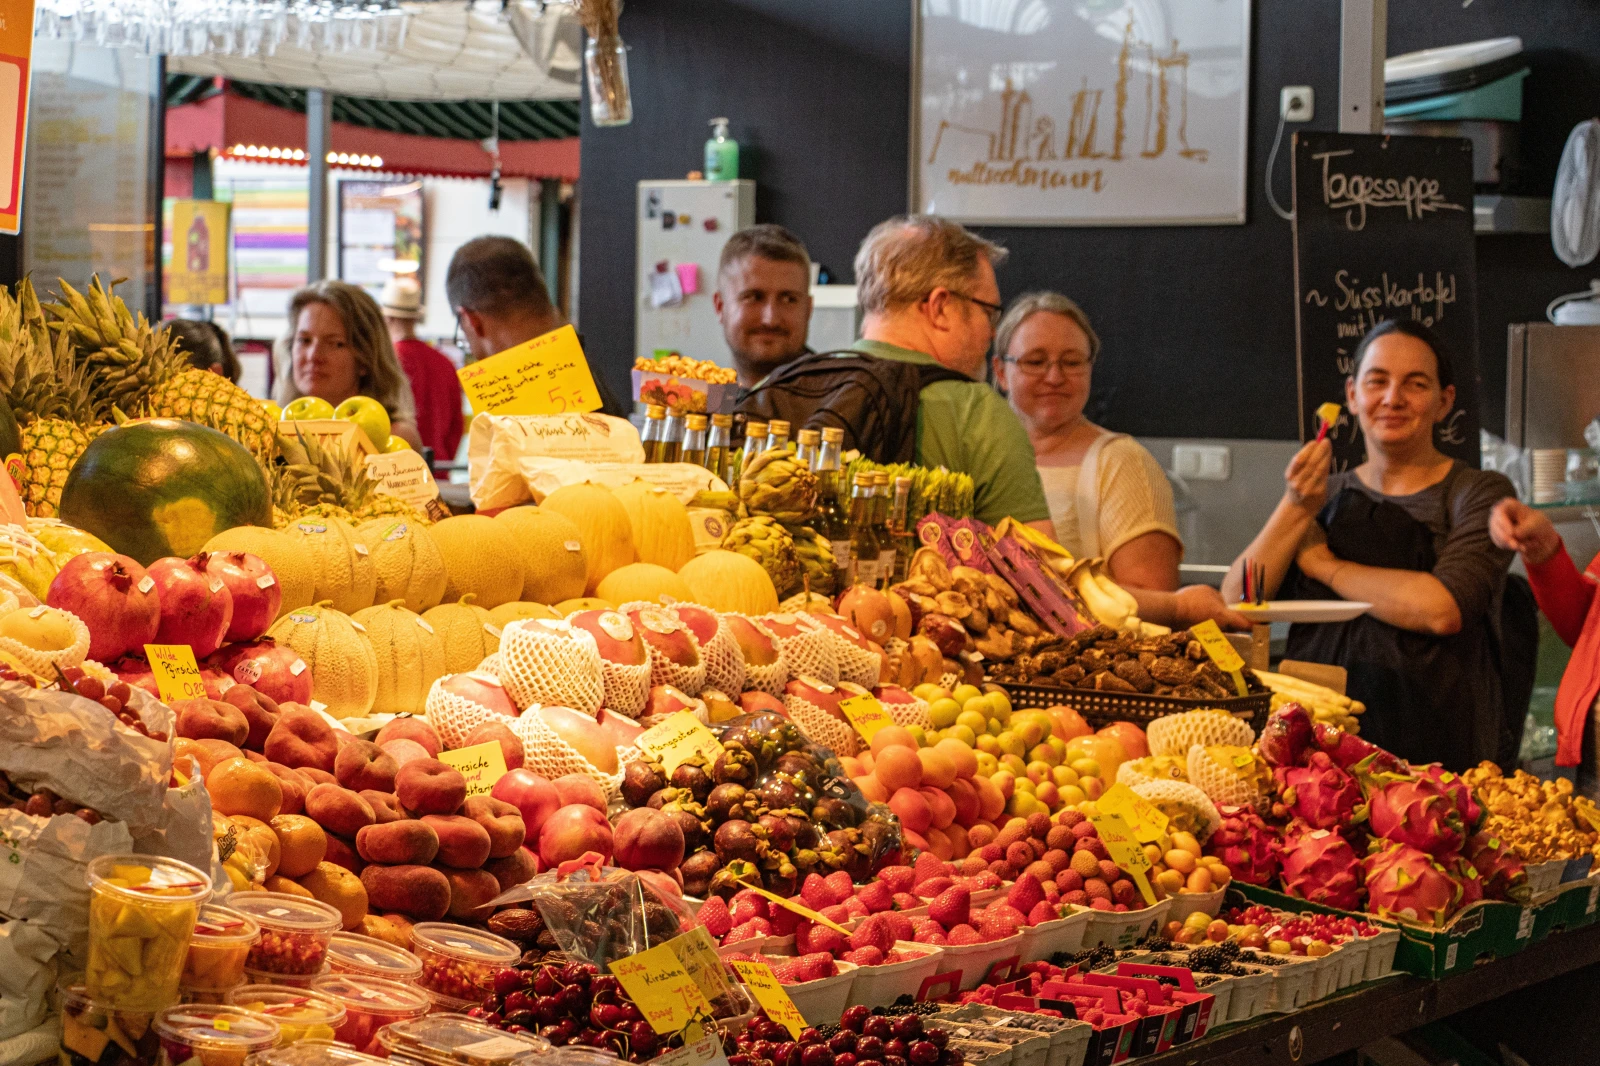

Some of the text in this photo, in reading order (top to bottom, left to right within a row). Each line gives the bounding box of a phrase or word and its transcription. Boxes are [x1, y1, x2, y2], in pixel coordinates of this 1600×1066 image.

[1312, 150, 1445, 231] Tagessuppe
[472, 374, 510, 390] Frische
[476, 361, 576, 400] Frankfurter grüne
[153, 647, 178, 661] Wilde
[648, 726, 701, 754] Mangosteen
[642, 968, 684, 987] Kirschen
